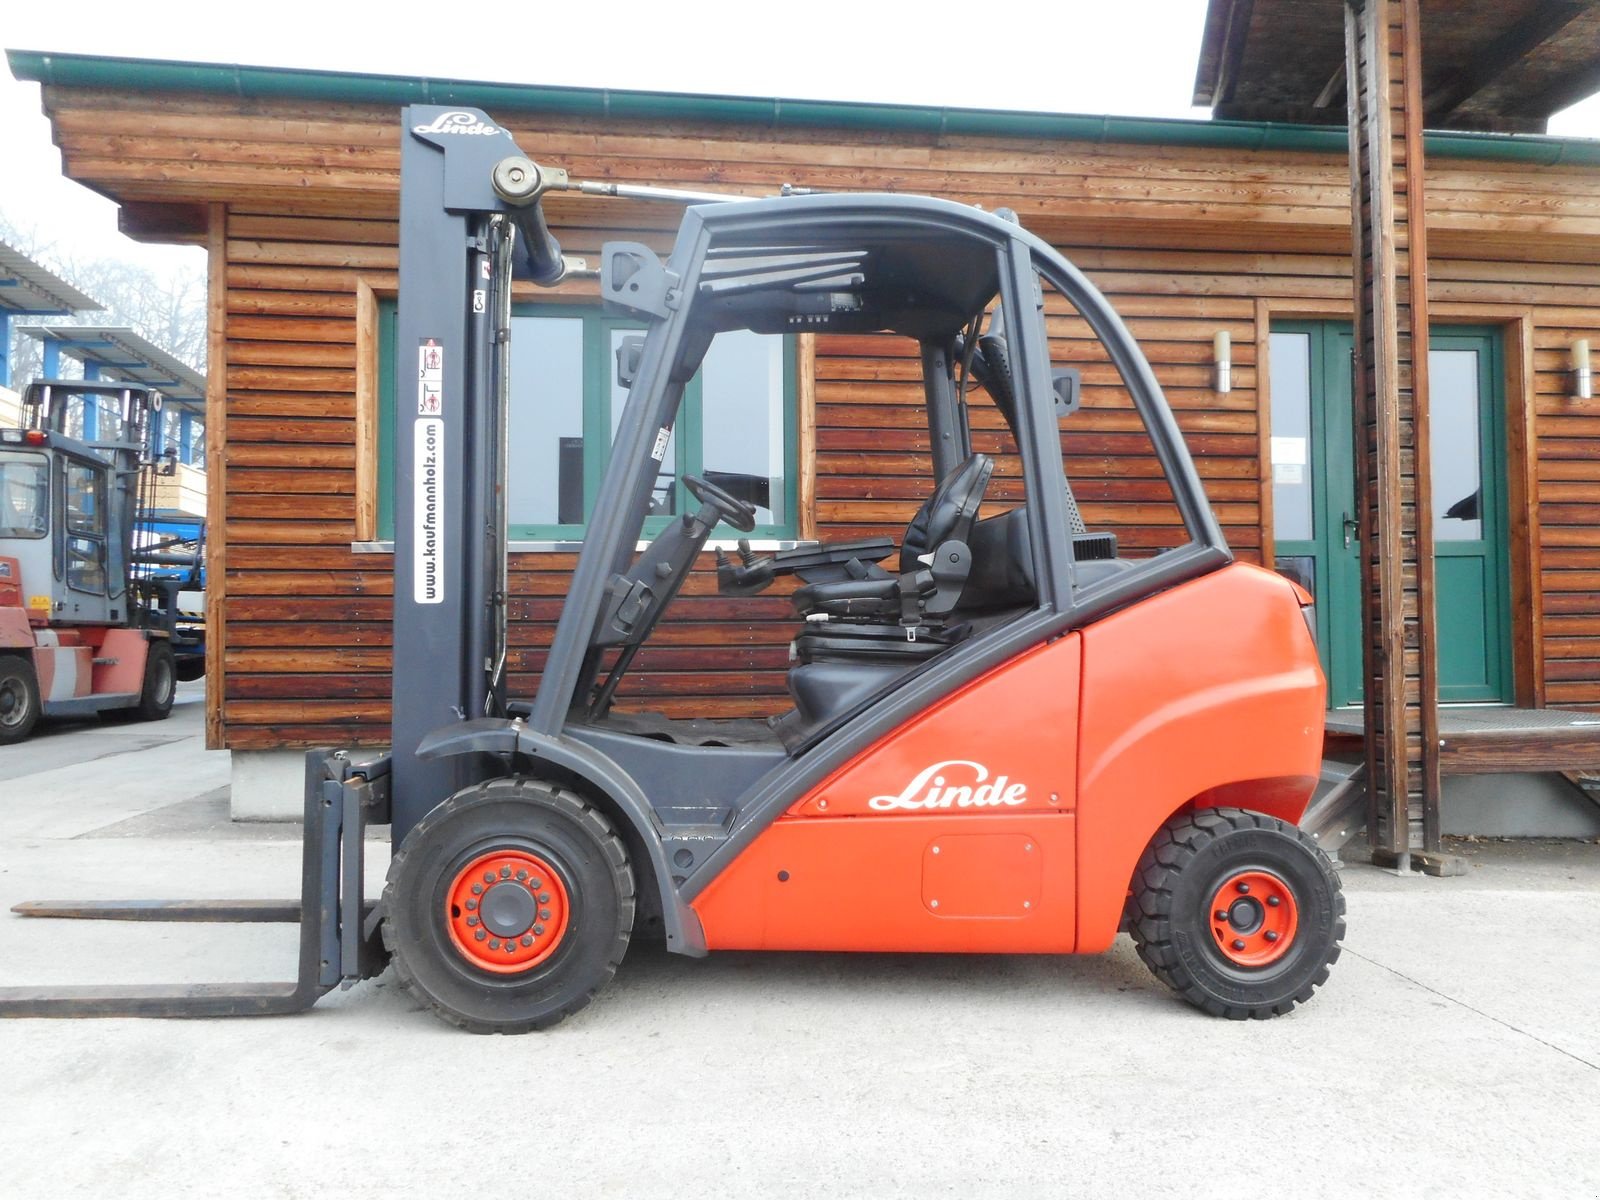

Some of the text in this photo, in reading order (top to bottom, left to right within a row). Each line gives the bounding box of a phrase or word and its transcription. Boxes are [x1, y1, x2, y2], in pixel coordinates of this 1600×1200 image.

[413, 111, 500, 136] Linde
[423, 424, 436, 600] www.kaufmannholz.com
[868, 760, 1027, 811] Linde
